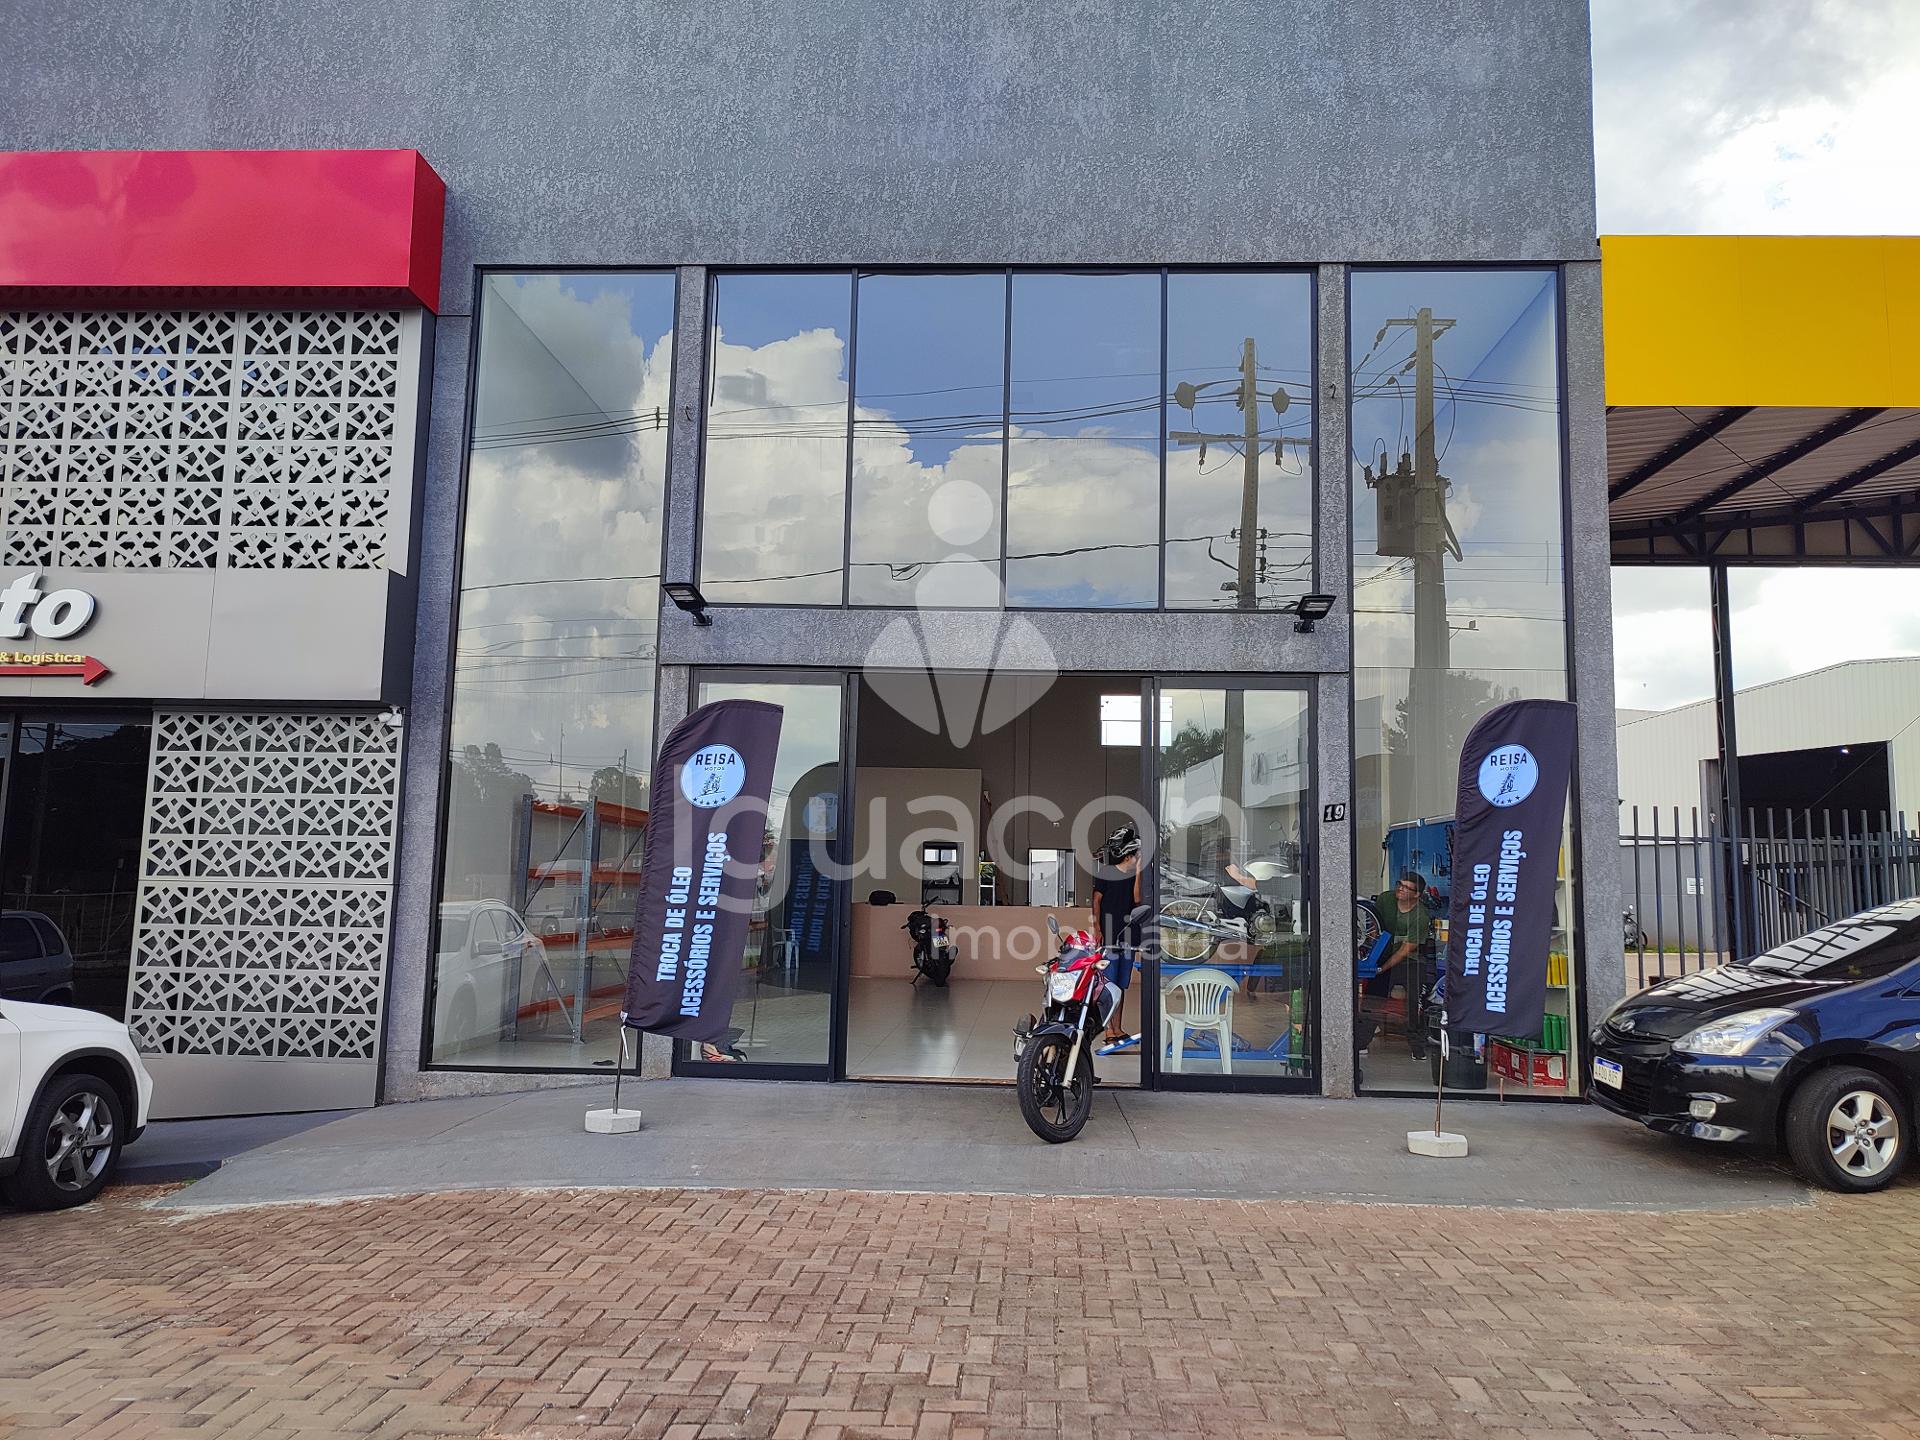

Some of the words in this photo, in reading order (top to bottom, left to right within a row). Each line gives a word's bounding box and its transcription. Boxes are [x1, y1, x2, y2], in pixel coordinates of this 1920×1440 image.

[0, 651, 8, 662] &
[15, 651, 82, 665] Logística
[695, 753, 736, 766] REISA
[1490, 752, 1527, 766] REISA
[1325, 805, 1344, 821] 19
[698, 832, 731, 906] SERVIÇOS
[1496, 830, 1527, 902] SERVIÇOS
[665, 866, 693, 904] ÓLEO
[1470, 864, 1492, 901] ÓLEO
[665, 908, 686, 928] DE
[695, 910, 716, 920] E
[1469, 905, 1486, 924] DE
[1494, 906, 1515, 916] E
[656, 932, 683, 981] TROCA
[1463, 928, 1484, 976] TROCA
[680, 924, 714, 1018] ACESSÓRIOS
[1484, 919, 1513, 1014] ACESSÓRIOS
